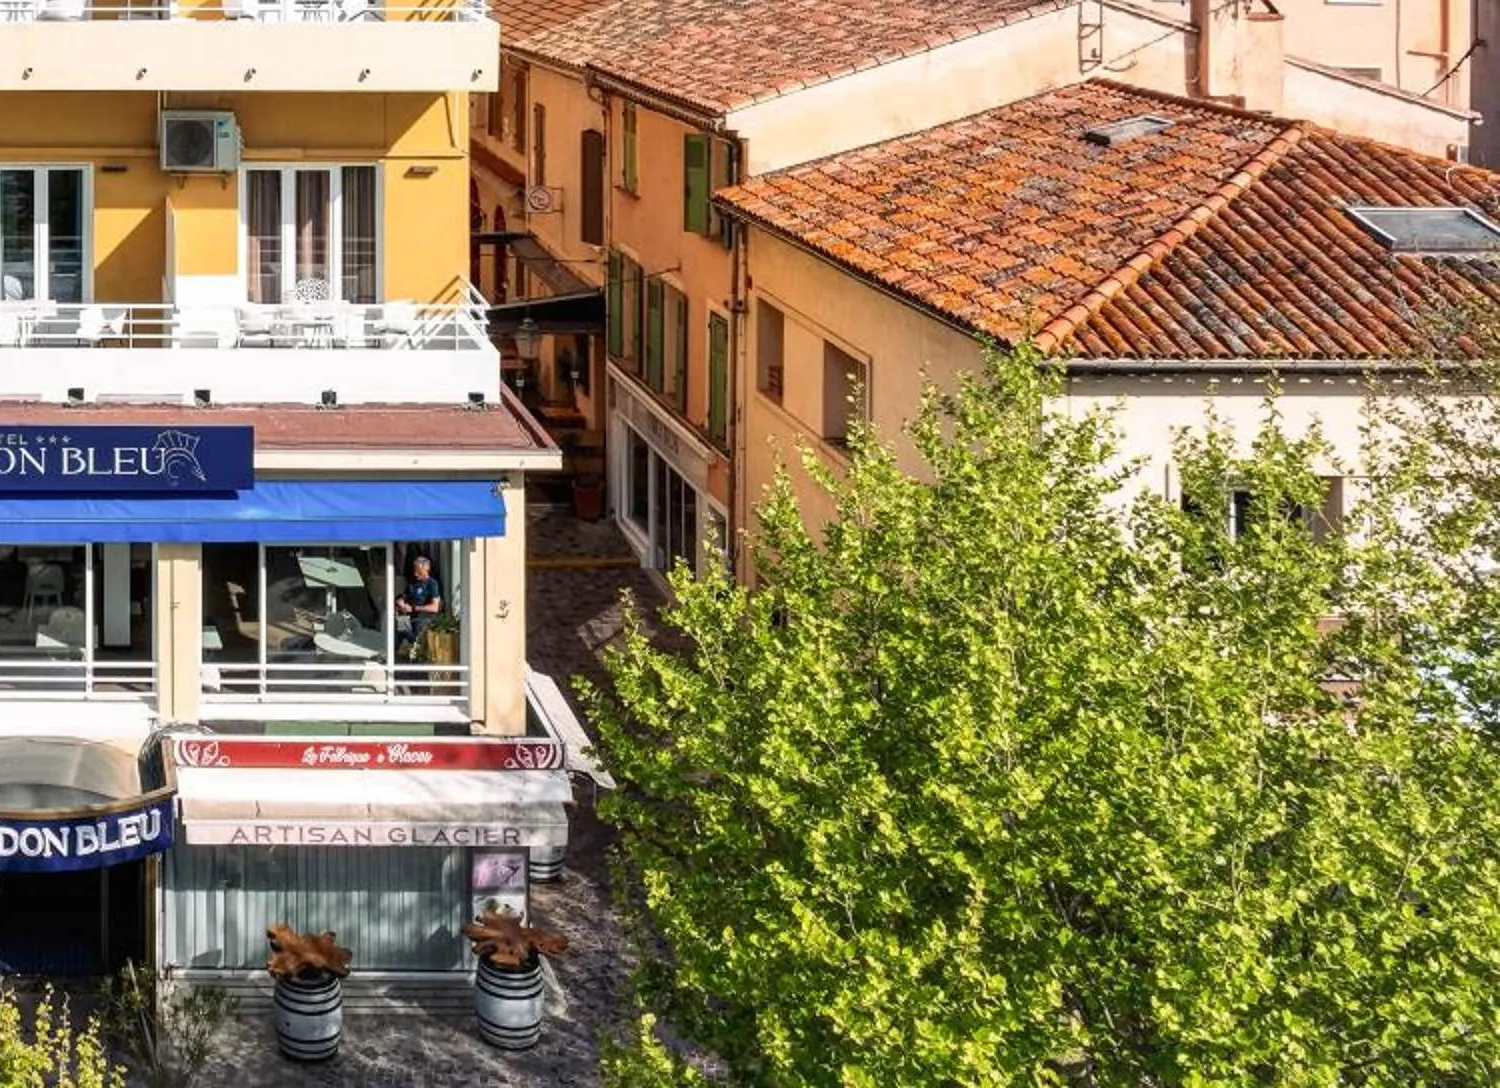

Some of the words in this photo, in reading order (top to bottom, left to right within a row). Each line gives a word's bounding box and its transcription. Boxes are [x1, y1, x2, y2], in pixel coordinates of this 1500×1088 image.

[61, 447, 167, 476] BLEU
[76, 808, 162, 856] BLEU
[230, 825, 373, 844] ARTISAN
[388, 826, 522, 845] GLACIER
